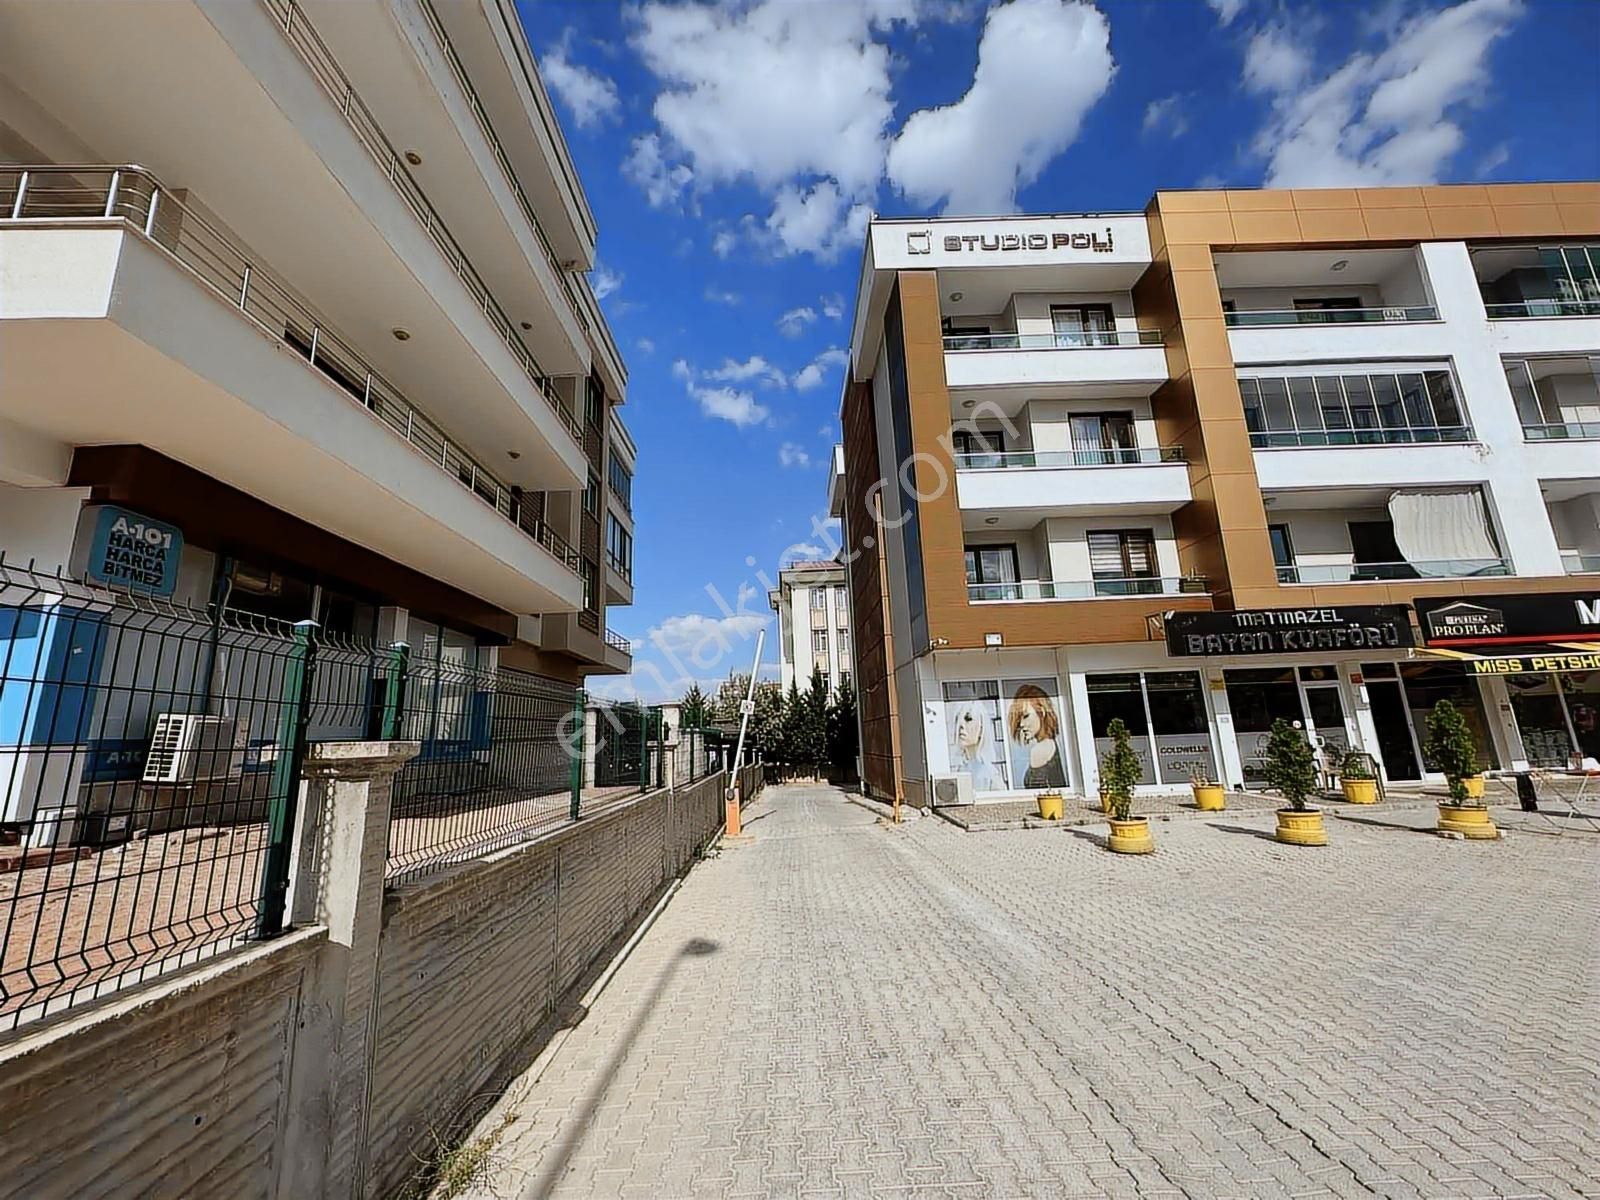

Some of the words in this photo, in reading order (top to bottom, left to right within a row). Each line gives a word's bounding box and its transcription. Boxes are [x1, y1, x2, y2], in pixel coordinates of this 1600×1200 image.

[944, 233, 1048, 252] STUDIO
[106, 545, 165, 576] HARCA
[109, 530, 167, 561] HARCA
[1186, 631, 1274, 653] BAYAN
[1280, 623, 1399, 650] KUAFÖRÜ
[1434, 625, 1464, 637] PRO
[1465, 623, 1502, 636] PLAN
